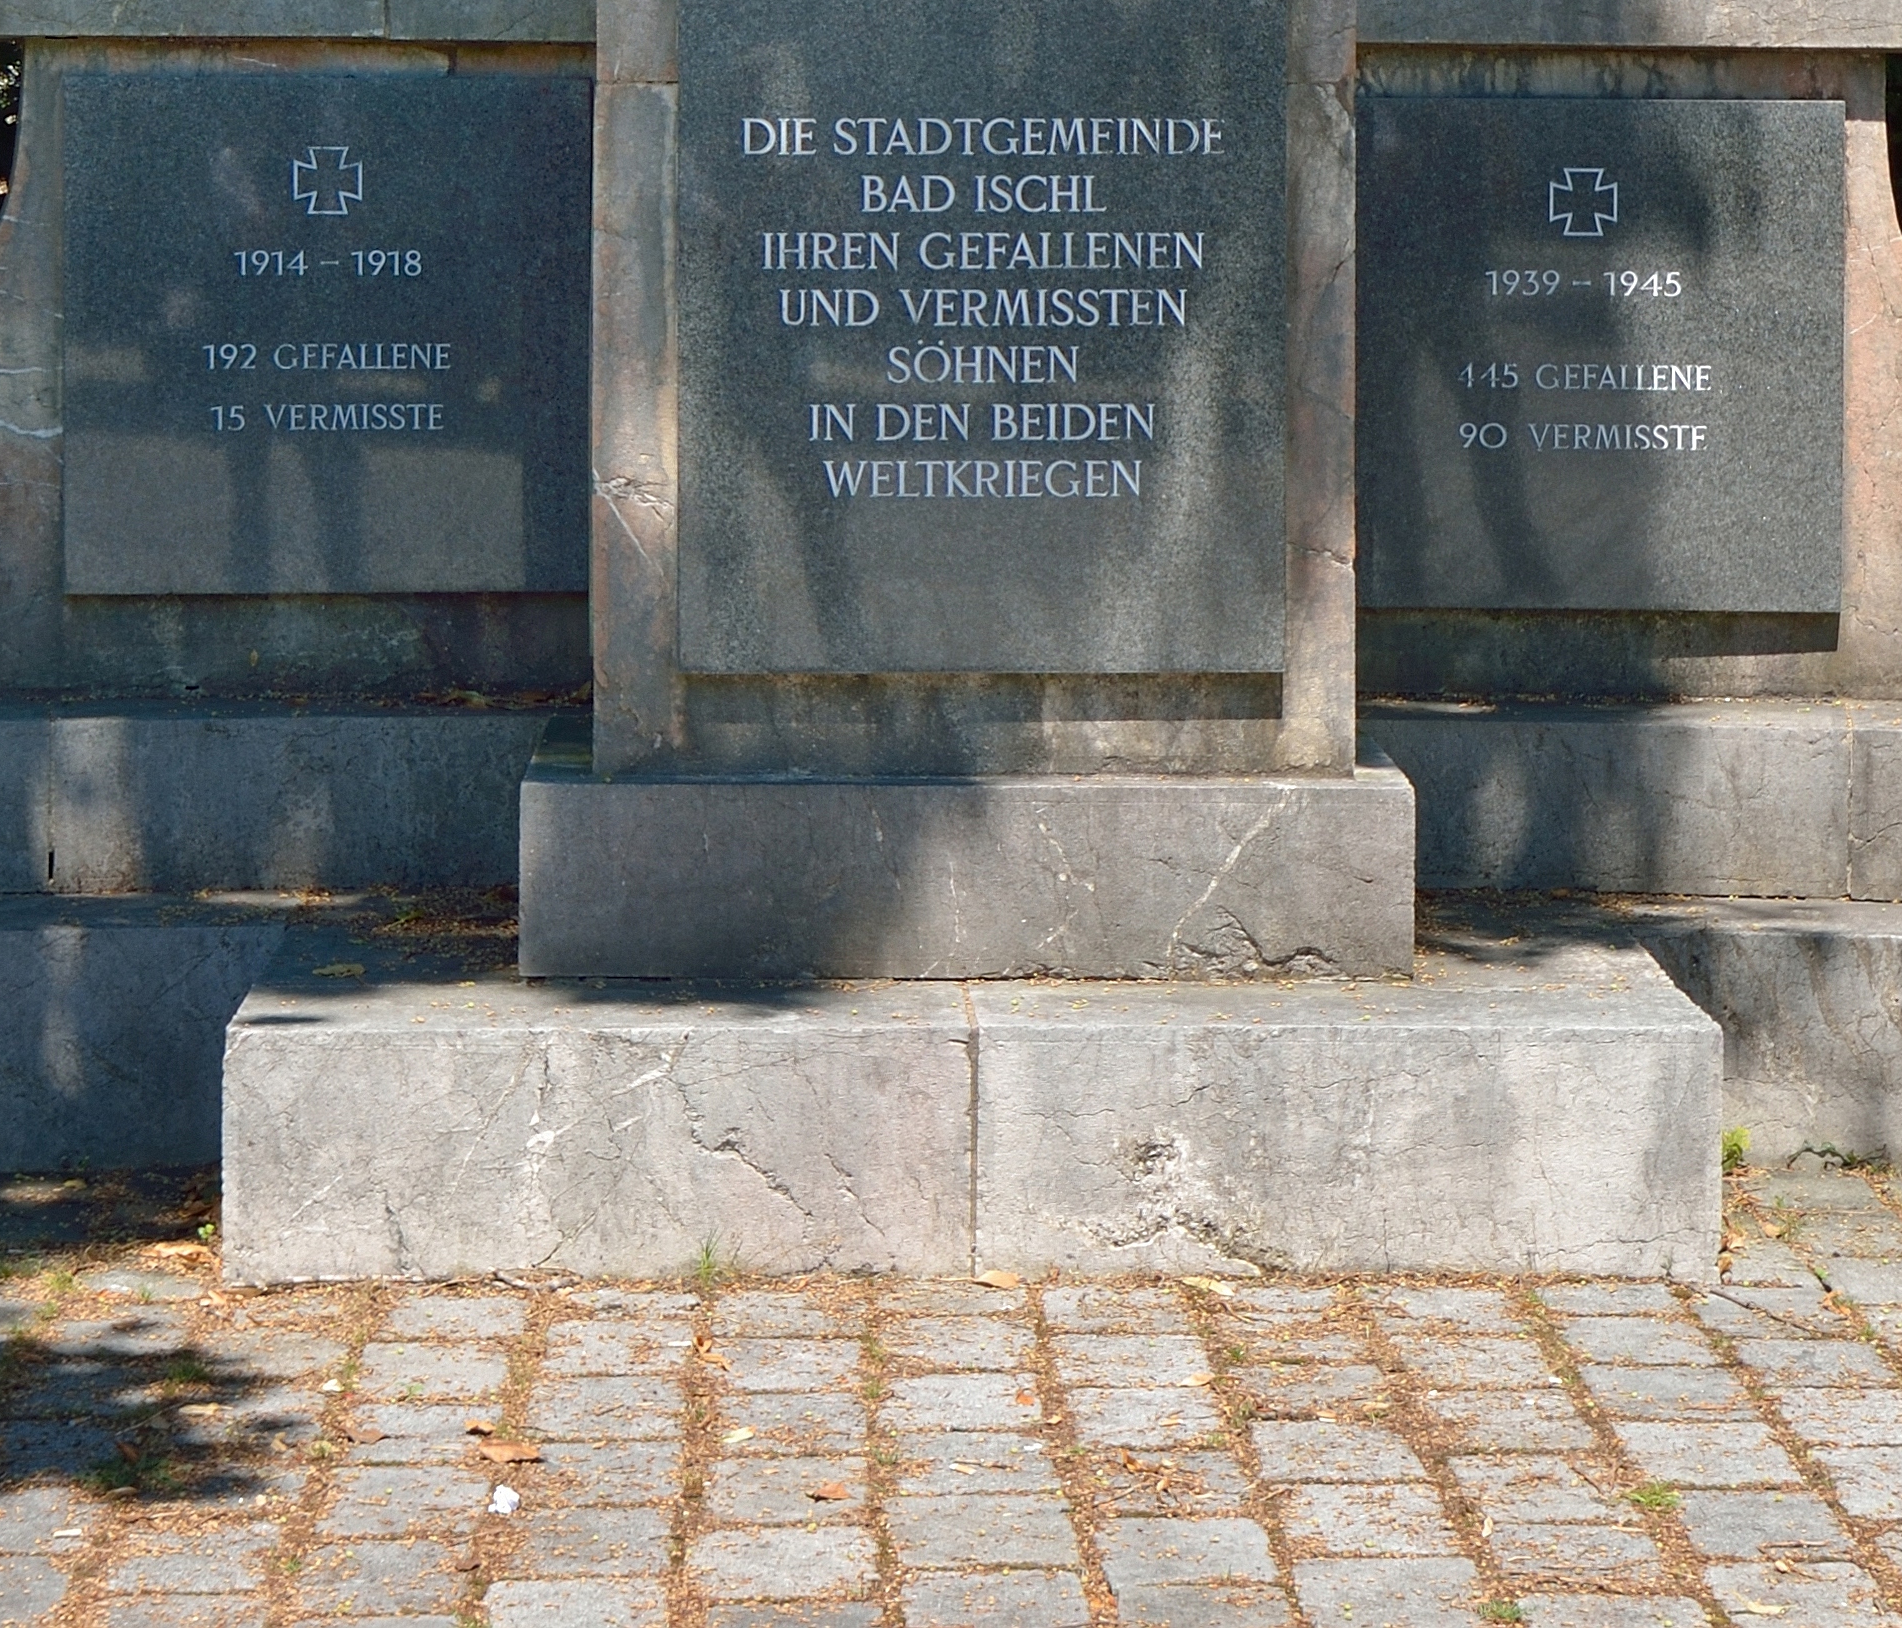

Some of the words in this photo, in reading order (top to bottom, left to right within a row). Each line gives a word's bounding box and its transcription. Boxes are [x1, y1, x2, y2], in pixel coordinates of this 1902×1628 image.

[741, 116, 817, 156] DIE
[833, 116, 1225, 156] STADTGEMEINDE
[861, 174, 956, 214] BAD
[975, 174, 1107, 214] ISCHL
[233, 249, 309, 277] 1914
[350, 249, 422, 277] 1918
[761, 231, 901, 271] IHREN
[919, 231, 1205, 271] GEFALLENEN
[1485, 269, 1561, 297] 1939
[1603, 269, 1683, 299] 1945
[779, 288, 880, 328] UND
[898, 288, 1188, 328] VERMISSTEN
[202, 343, 257, 371] 192
[273, 342, 452, 371] GEFALLENE
[886, 338, 1080, 385] SÖHNEN
[1458, 362, 1519, 390] 445
[1535, 362, 1713, 392] GEFALLENE
[210, 404, 246, 432] 15
[264, 403, 445, 432] VERMISSTE
[809, 403, 857, 442] IN
[875, 403, 971, 442] DEN
[991, 402, 1155, 442] BEIDEN
[1458, 422, 1508, 450] 90
[1528, 423, 1708, 452] VERMISSTE
[823, 459, 1142, 499] WELTKRIEGEN
